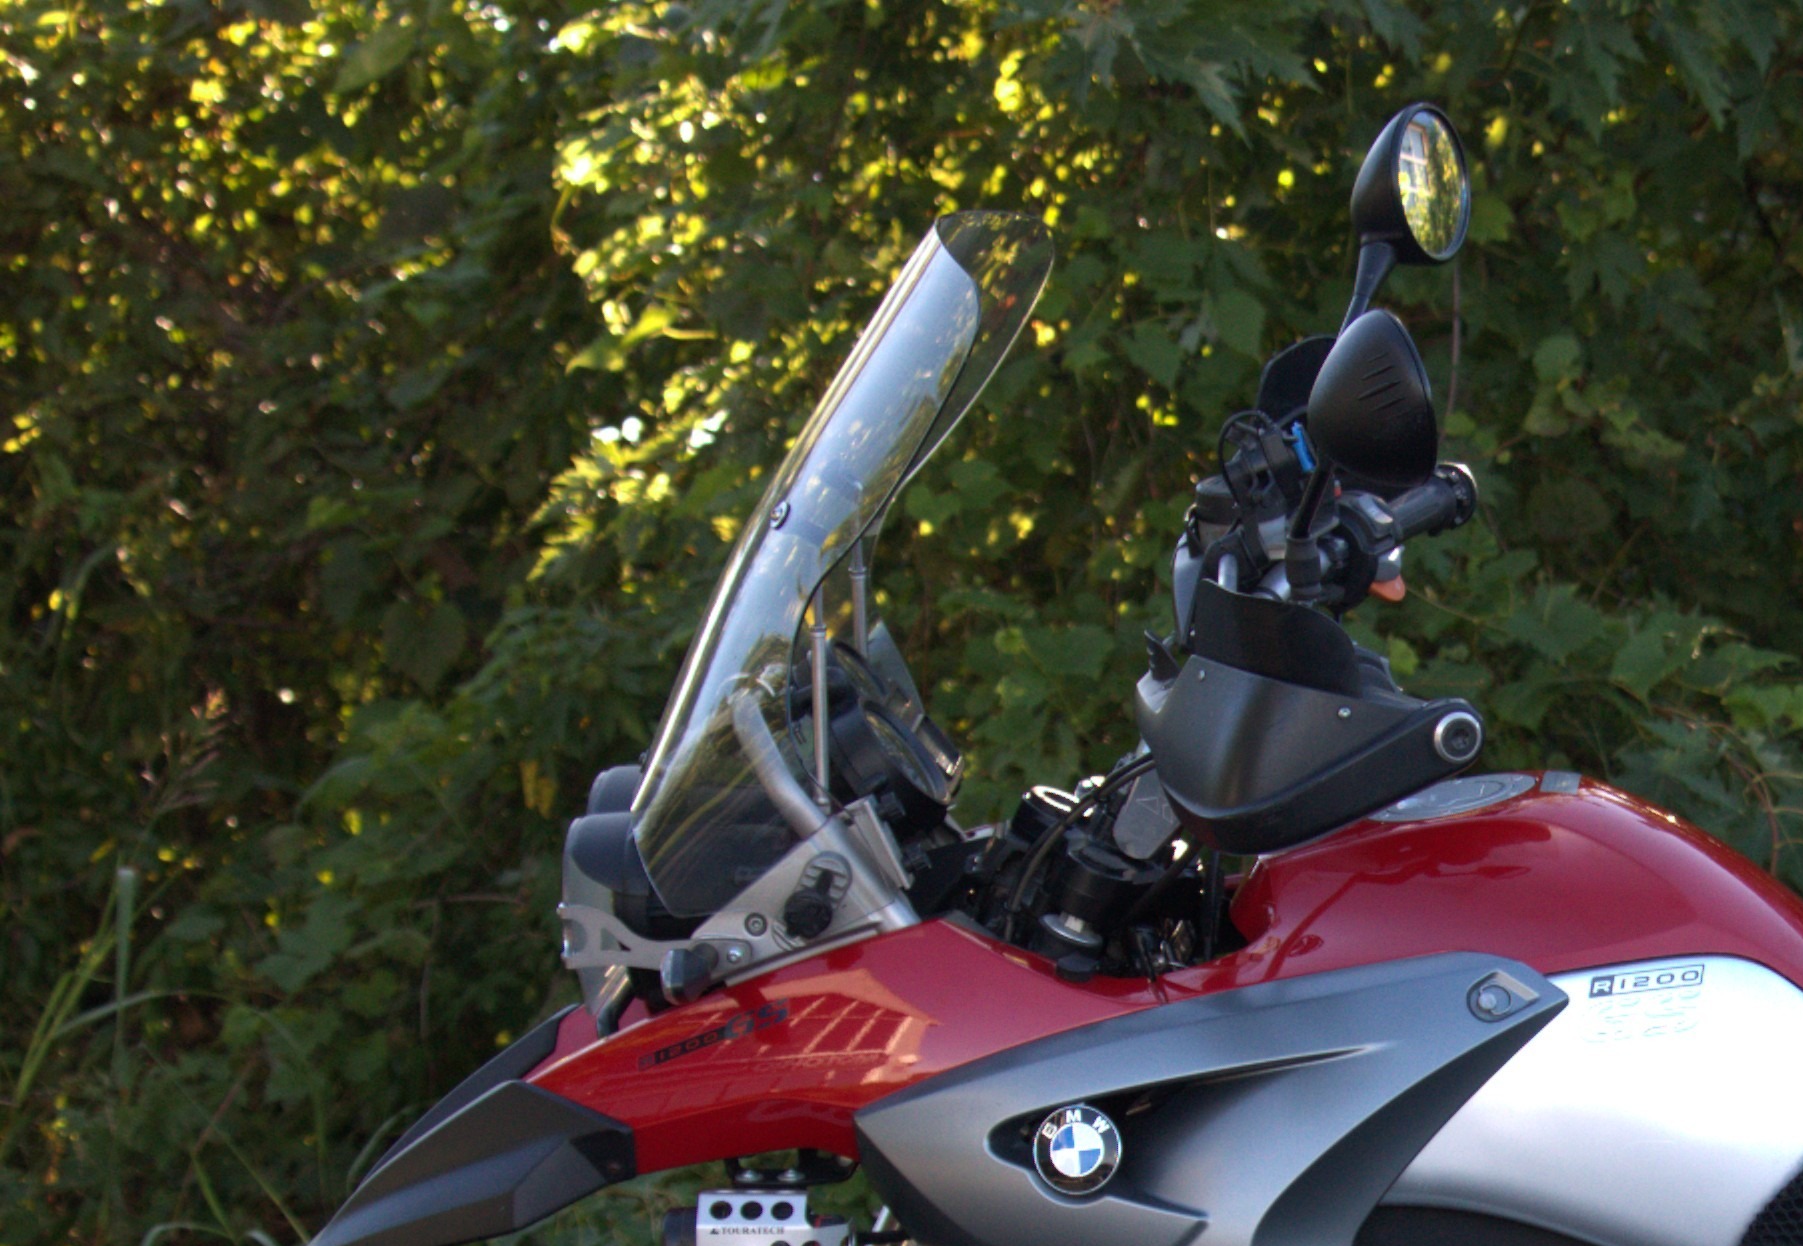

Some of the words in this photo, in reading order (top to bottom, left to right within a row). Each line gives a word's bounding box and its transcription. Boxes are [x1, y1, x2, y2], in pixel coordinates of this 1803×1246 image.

[1591, 969, 1700, 995] R1200
[1042, 1109, 1110, 1139] BMW
[720, 1227, 785, 1235] TOURATECH
